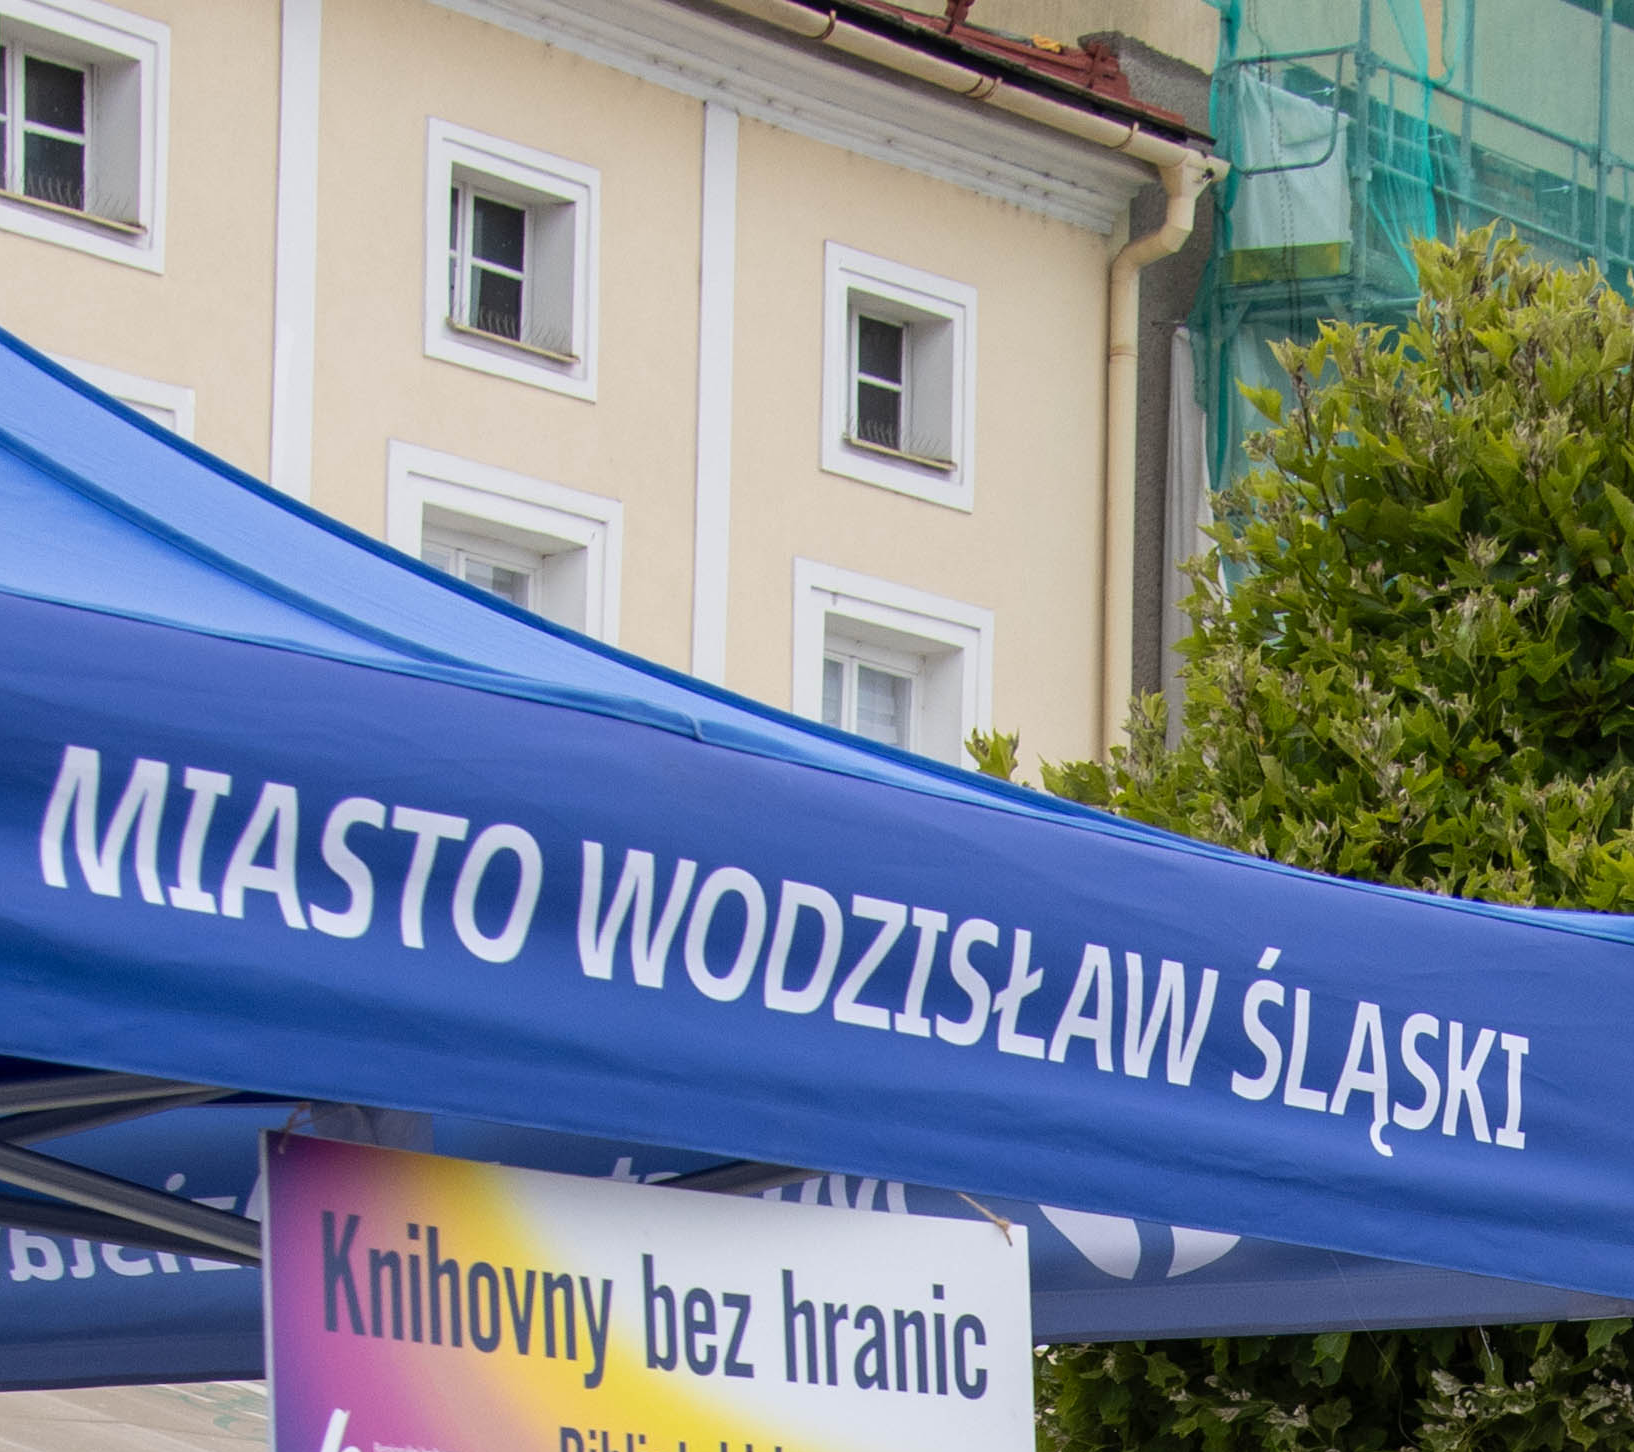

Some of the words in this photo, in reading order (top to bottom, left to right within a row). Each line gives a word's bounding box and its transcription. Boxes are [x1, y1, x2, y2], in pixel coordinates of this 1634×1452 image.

[40, 745, 543, 963] MIASTO
[577, 840, 1219, 1087] WODZISŁAW
[1231, 946, 1530, 1157] ŚLĄSKI
[321, 1210, 613, 1389] Knihovny
[641, 1253, 755, 1379] bez
[781, 1268, 988, 1400] hranic
